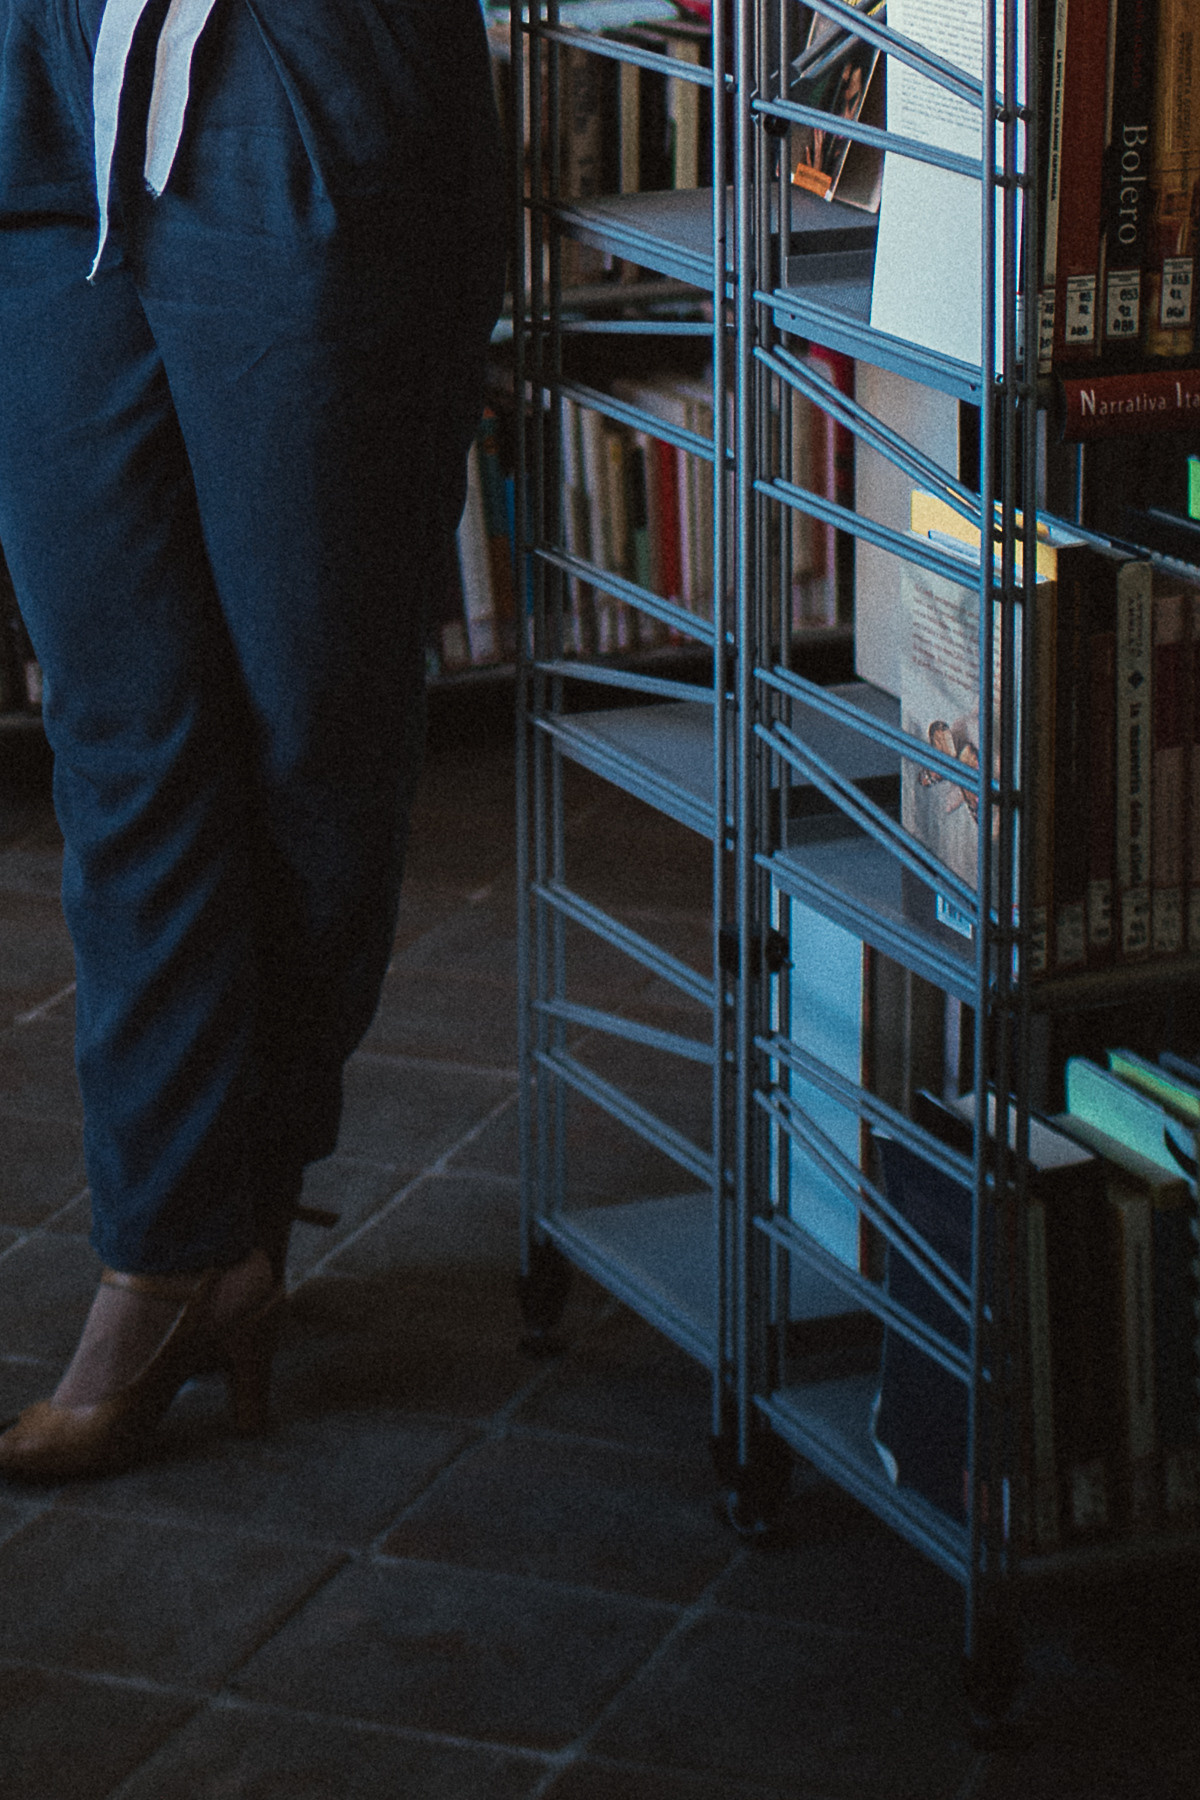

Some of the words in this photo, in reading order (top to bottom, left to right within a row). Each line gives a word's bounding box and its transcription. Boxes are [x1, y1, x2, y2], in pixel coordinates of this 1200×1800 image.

[1057, 49, 1062, 60] LA
[1118, 124, 1148, 244] Bolero
[1080, 389, 1167, 416] Narrativa
